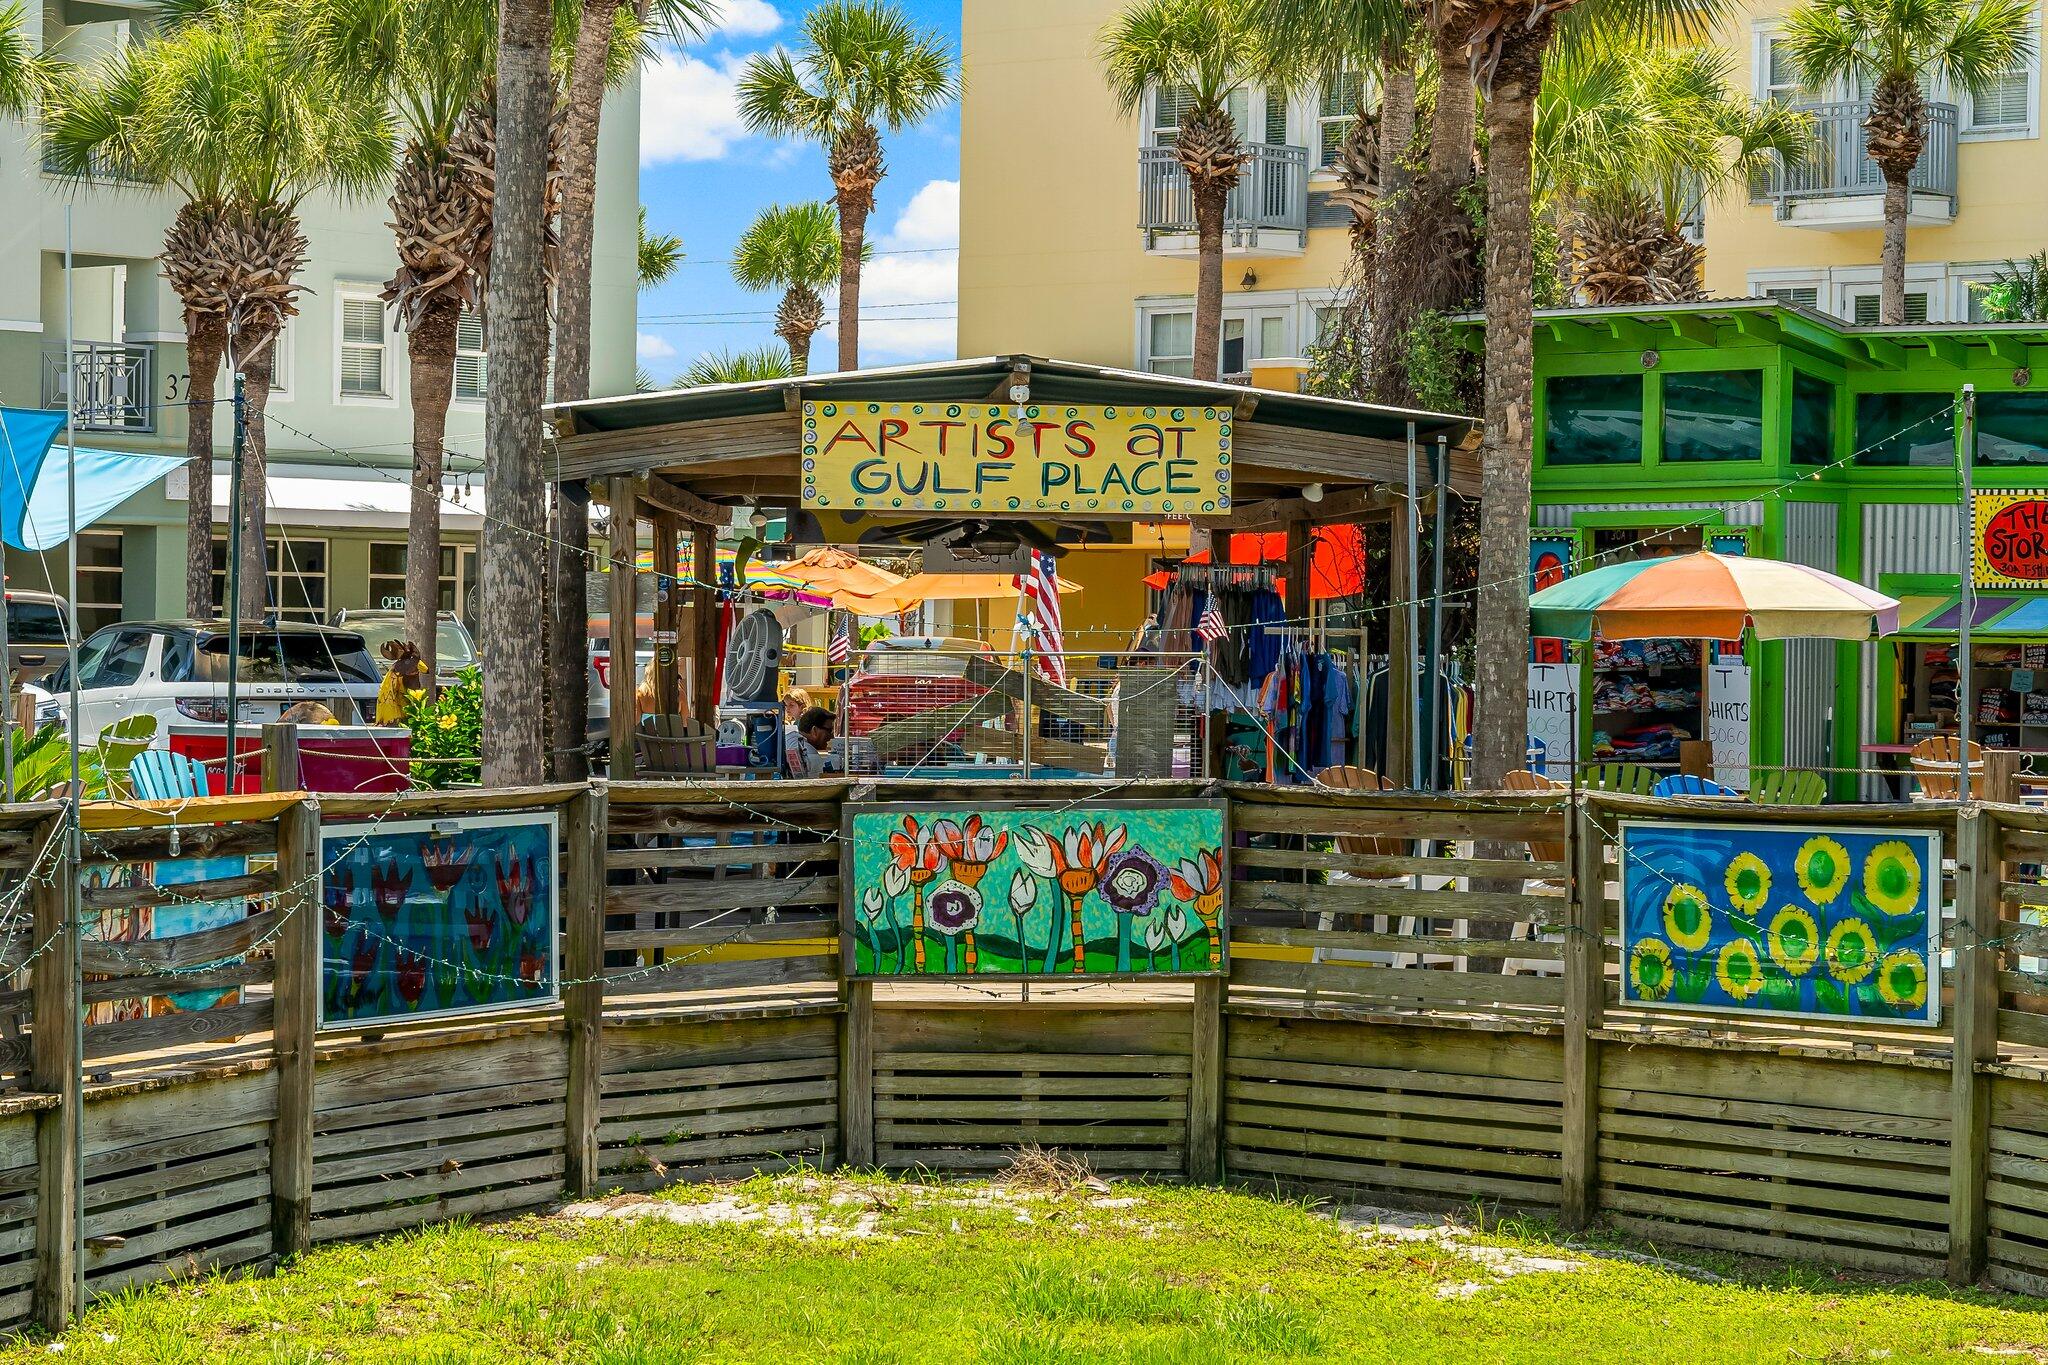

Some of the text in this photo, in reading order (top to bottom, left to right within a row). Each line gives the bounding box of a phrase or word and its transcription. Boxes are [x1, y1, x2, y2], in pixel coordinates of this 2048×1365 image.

[823, 420, 1096, 459] ARTISTS
[850, 459, 1201, 497] GULF PLACE
[1990, 528, 2048, 562] STOR
[2022, 562, 2048, 577] T-SHI
[1533, 665, 1555, 682] T
[1715, 669, 1733, 689] T
[1527, 689, 1577, 713] HIRTS
